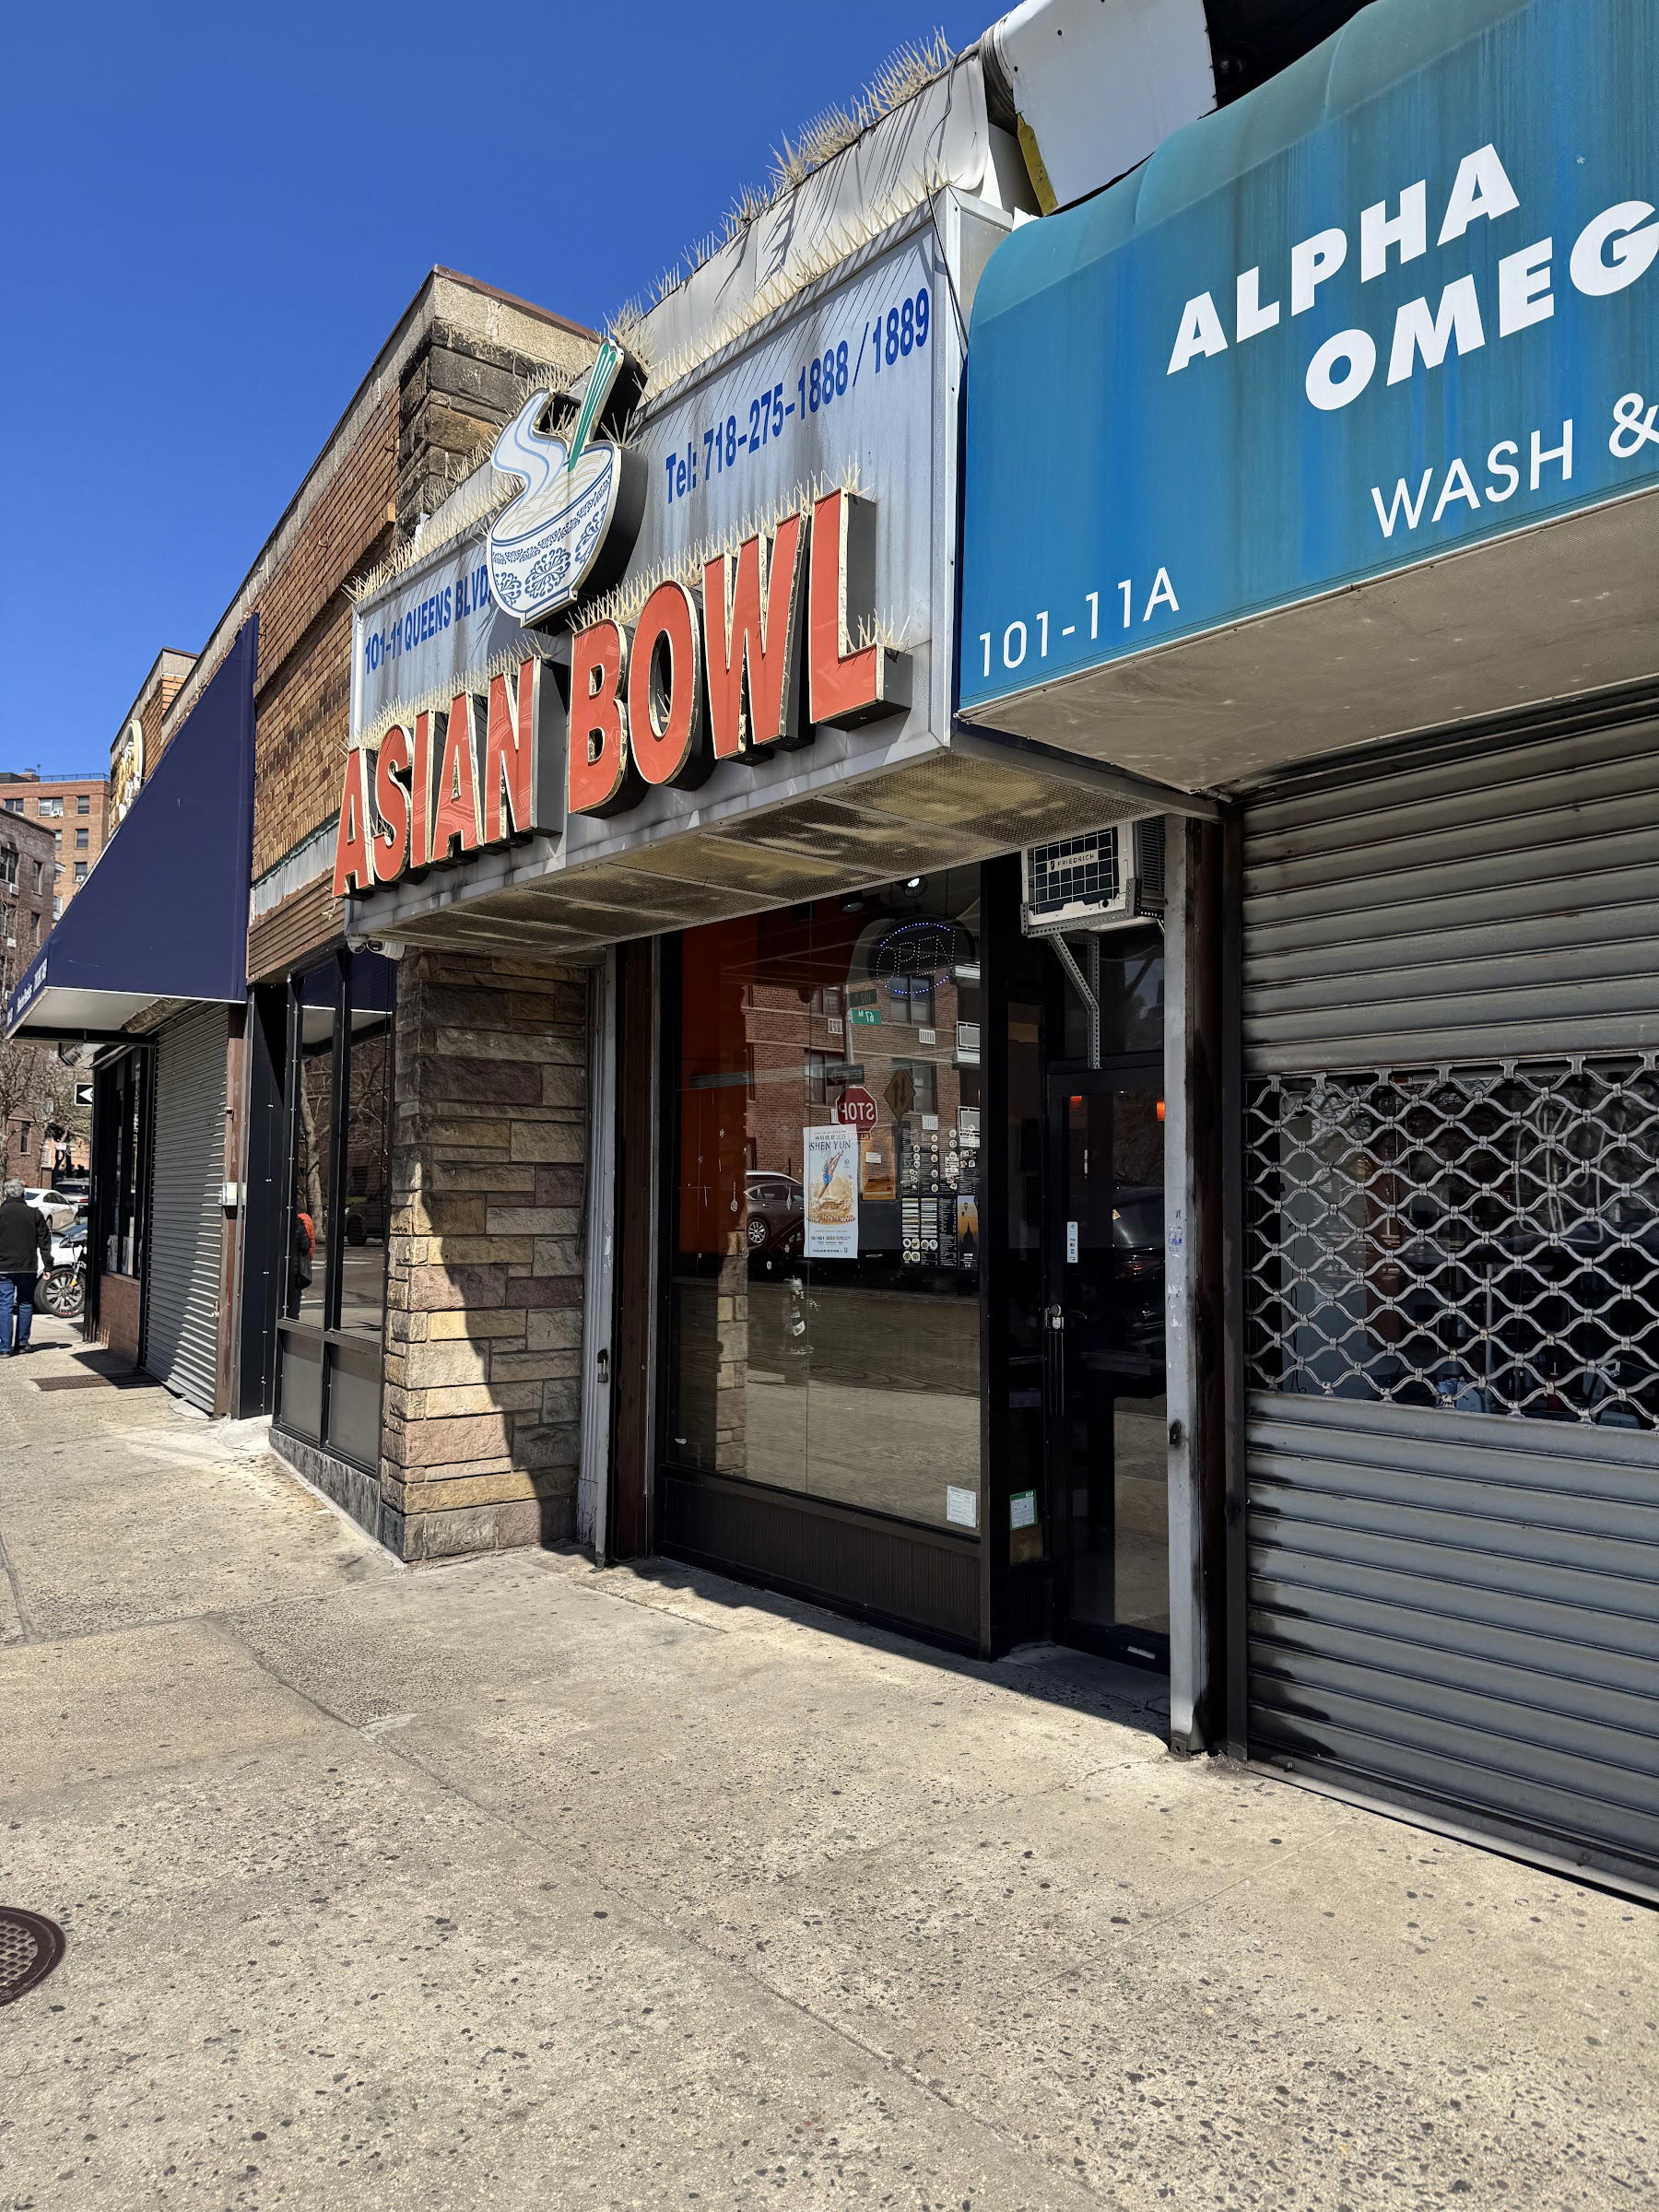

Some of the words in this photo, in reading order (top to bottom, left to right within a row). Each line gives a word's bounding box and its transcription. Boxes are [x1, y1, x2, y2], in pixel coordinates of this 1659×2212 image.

[1166, 143, 1521, 375] ALPHA
[665, 441, 697, 504] Tel:
[1371, 418, 1574, 538] WASH
[1608, 393, 1659, 458] &
[365, 618, 403, 675] 101-11
[405, 586, 452, 653] QUEENS
[979, 567, 1181, 677] 101-11A
[332, 654, 540, 898] ASIAN
[568, 487, 885, 815] BOWL
[1057, 853, 1095, 866] FRIEDRICH
[876, 929, 956, 984] OPEN
[809, 1141, 831, 1151] SHEN
[833, 1139, 851, 1150] YUN
